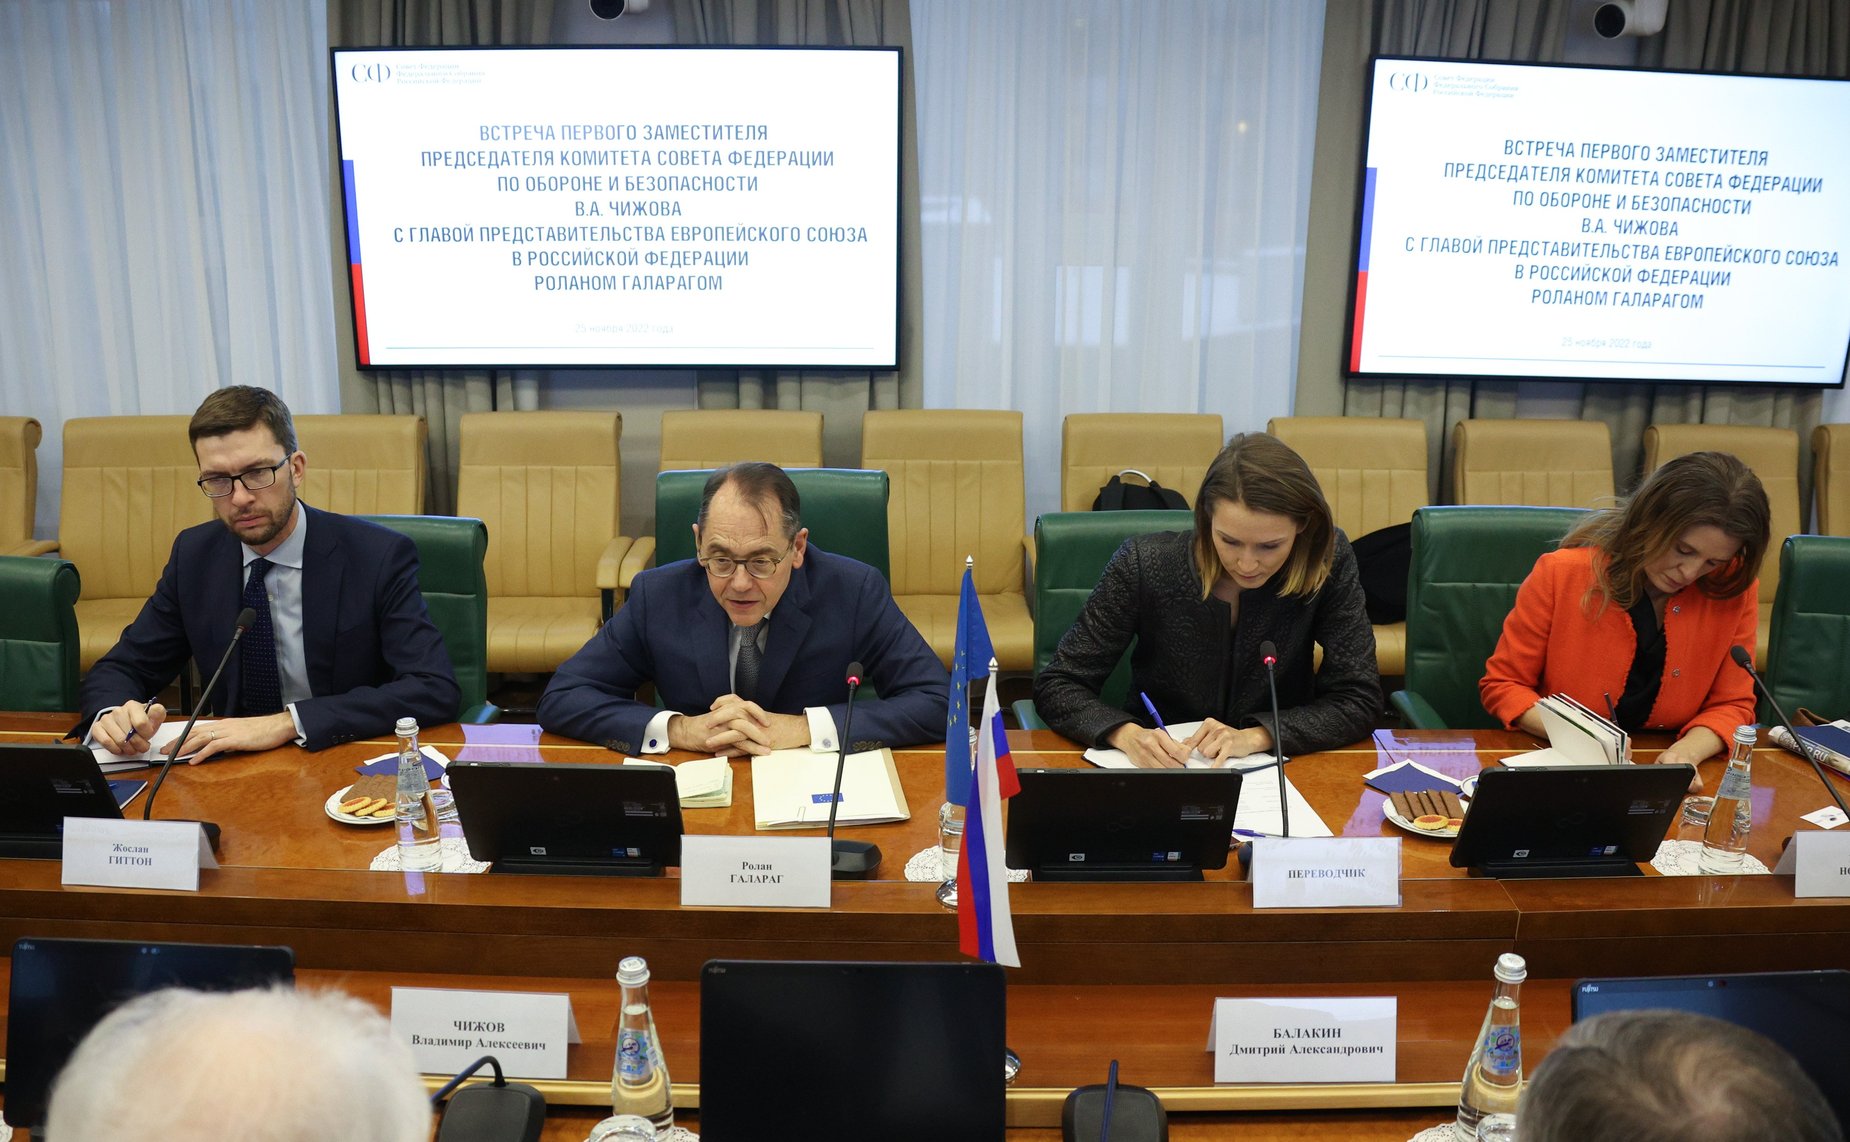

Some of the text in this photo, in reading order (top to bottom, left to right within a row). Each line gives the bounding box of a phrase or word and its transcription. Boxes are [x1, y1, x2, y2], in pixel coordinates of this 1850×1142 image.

[480, 125, 767, 141] ВСТРЕЧА ПЕРВОГО ЗАМЕСТИТЕЛЯ
[422, 150, 834, 169] ПРЕДСЕДАТЕЛЯ КОМИТЕТА СОВЕТА ФЕДЕРАЦИИ
[1505, 140, 1769, 166] ВСТРЕЧА ПЕРВОГО ЗАМЕСТИТЕЛЯ
[498, 176, 757, 191] ПО ОБОРОНЕ И БЕЗОПАСНОСТИ
[1445, 163, 1823, 195] ПРЕДСЕДАТЕЛЯ КОМИТЕТА СОВЕТА ФЕДЕРАЦИИ
[576, 201, 681, 216] В.А. ЧИЖОВА
[1514, 191, 1752, 215] ПО ОБОРОНЕ И БЕЗОПАСНОСТИ
[394, 224, 867, 244] С ГЛАВОЙ ПРЕДСТАВИТЕЛЬСТВА ЕВРОПЕЙСКОГО СОЮЗА
[1582, 218, 1679, 236] В.А. ЧИЖОВА
[512, 248, 748, 268] В РОССИЙСКОЙ ФЕДЕРАЦИИ
[1406, 236, 1839, 266] С ГЛАВОЙ ПРЕДСТАВИТЕЛЬСТВА ЕВРОПЕЙСКОГО СОЮЗА
[535, 275, 722, 290] РОЛАНОМ ГАЛАРАГОМ
[1515, 263, 1731, 287] В РОССИЙСКОЙ ФЕДЕРАЦИИ
[1532, 289, 1704, 309] РОЛАНОМ ГАЛАРАГОМ
[112, 843, 149, 853] Жослан
[108, 855, 153, 866] ГИТТОН
[742, 861, 772, 871] Ролан
[729, 874, 784, 884] ГАЛАРАГ
[1288, 868, 1366, 880] ПЕРЕВОДЧИК
[453, 1020, 505, 1033] ЧИЖОВ
[1273, 1028, 1342, 1039] БАЛАКИН
[411, 1034, 546, 1051] Владимир Алексеевич
[1229, 1042, 1384, 1057] Дмитрий Александрович
